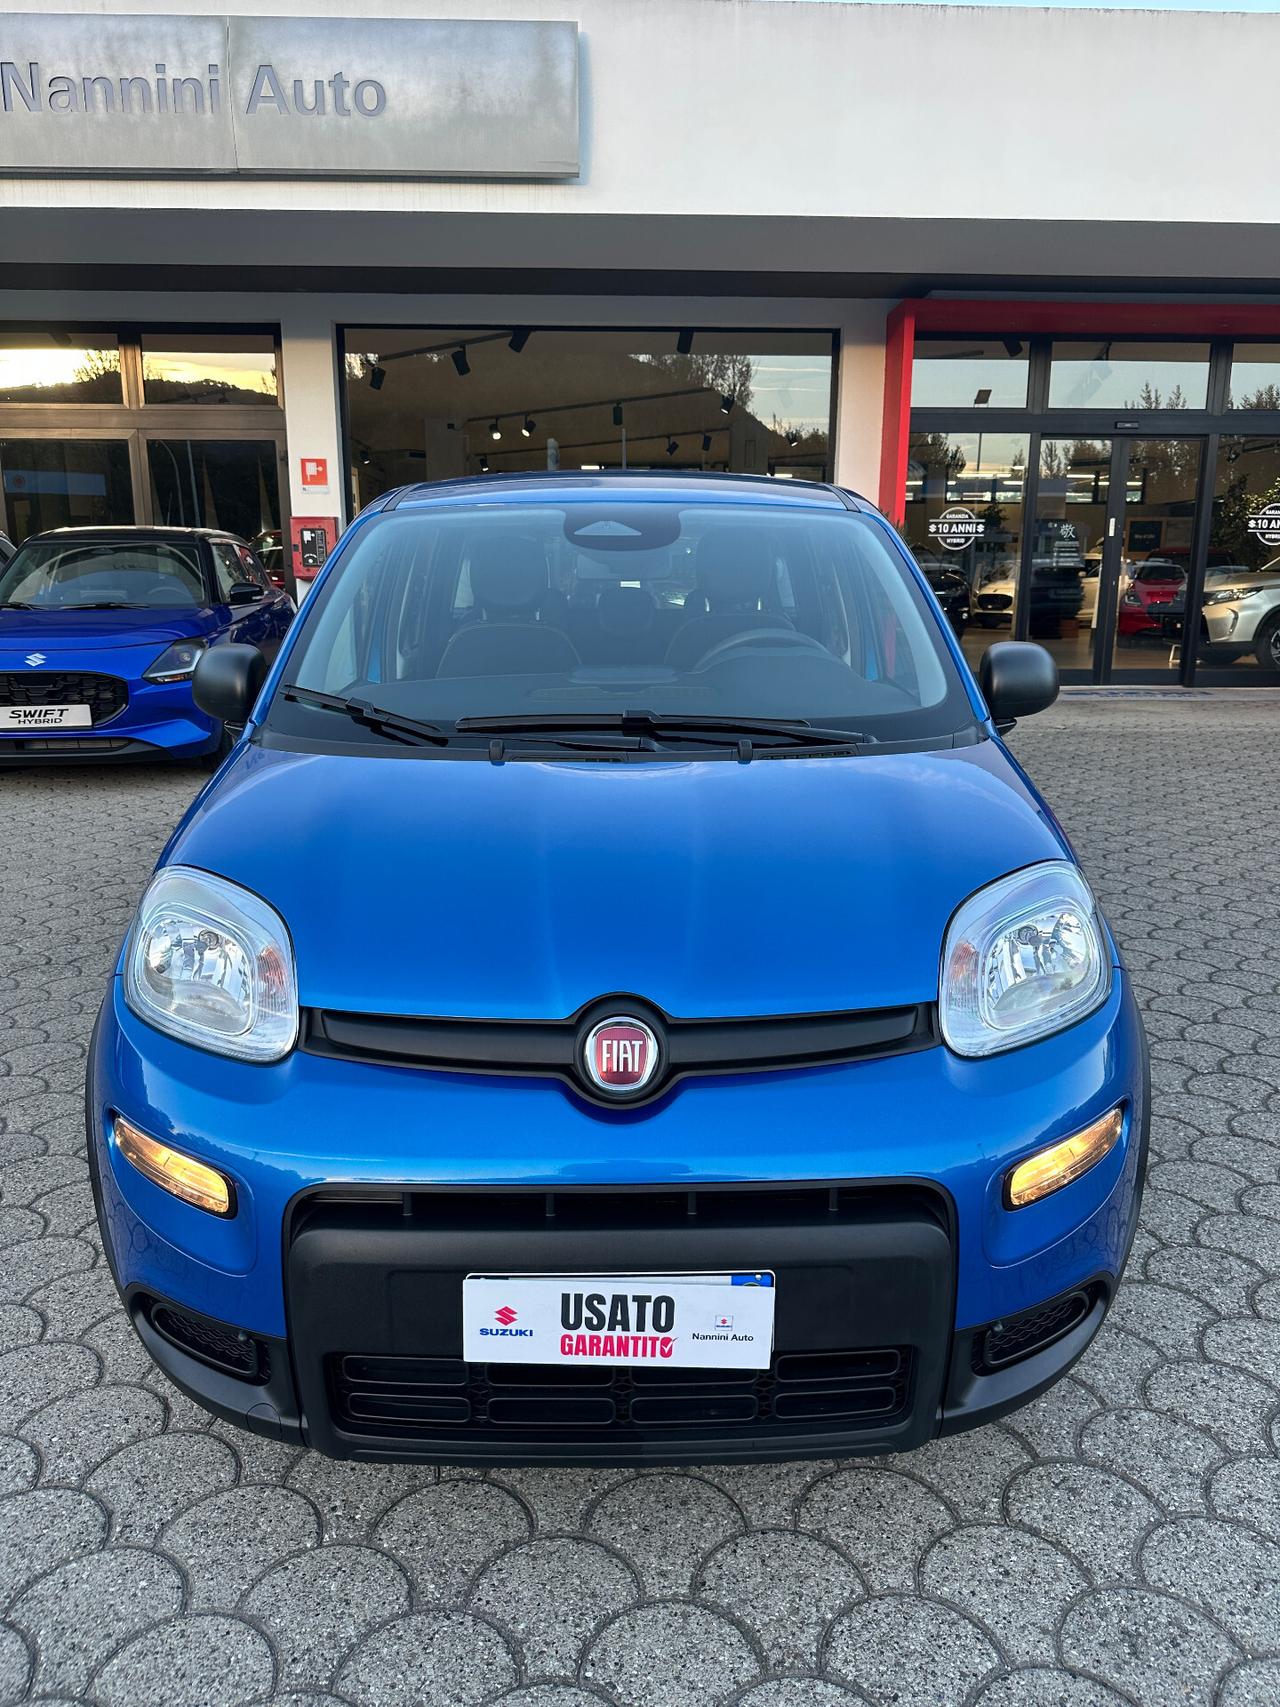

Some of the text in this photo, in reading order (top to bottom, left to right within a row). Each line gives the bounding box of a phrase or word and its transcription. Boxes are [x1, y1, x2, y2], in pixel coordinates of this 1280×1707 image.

[0, 61, 387, 118] Nannini Auto
[937, 523, 976, 534] 10 ANNI
[1257, 519, 1269, 529] 10
[9, 708, 70, 719] SWIFT
[17, 717, 63, 725] HYBRID
[601, 1039, 644, 1073] FIAT
[560, 1292, 676, 1334] USATO
[479, 1327, 534, 1337] SUZUKI
[691, 1332, 754, 1342] Nannini Auto
[560, 1333, 676, 1359] GARANTITO
